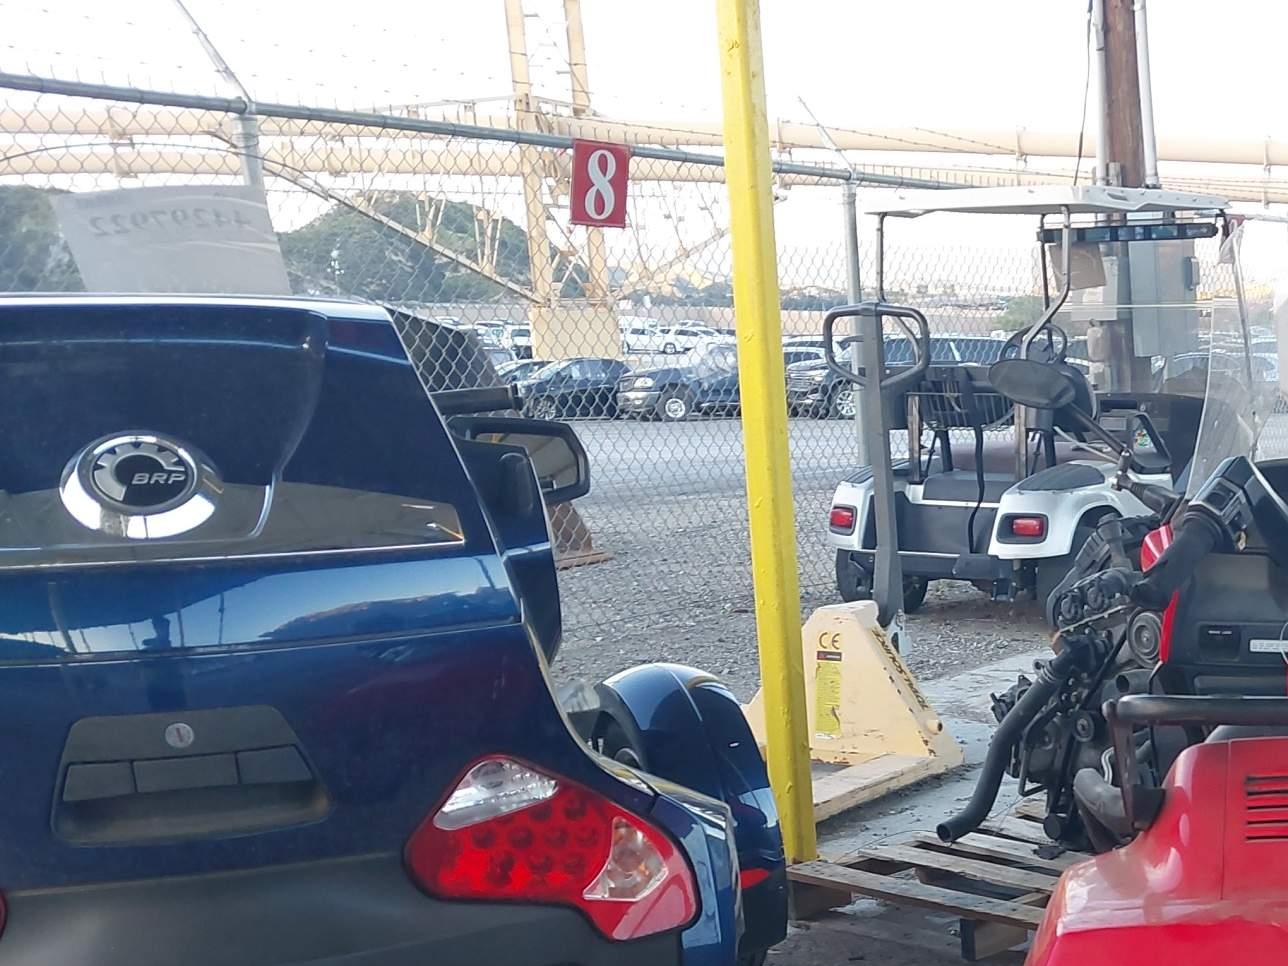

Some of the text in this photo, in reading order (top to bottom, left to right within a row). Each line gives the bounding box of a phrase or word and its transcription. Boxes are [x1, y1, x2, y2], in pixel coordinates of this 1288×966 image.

[585, 149, 616, 220] 8
[132, 473, 187, 485] BRP
[819, 632, 841, 650] CE
